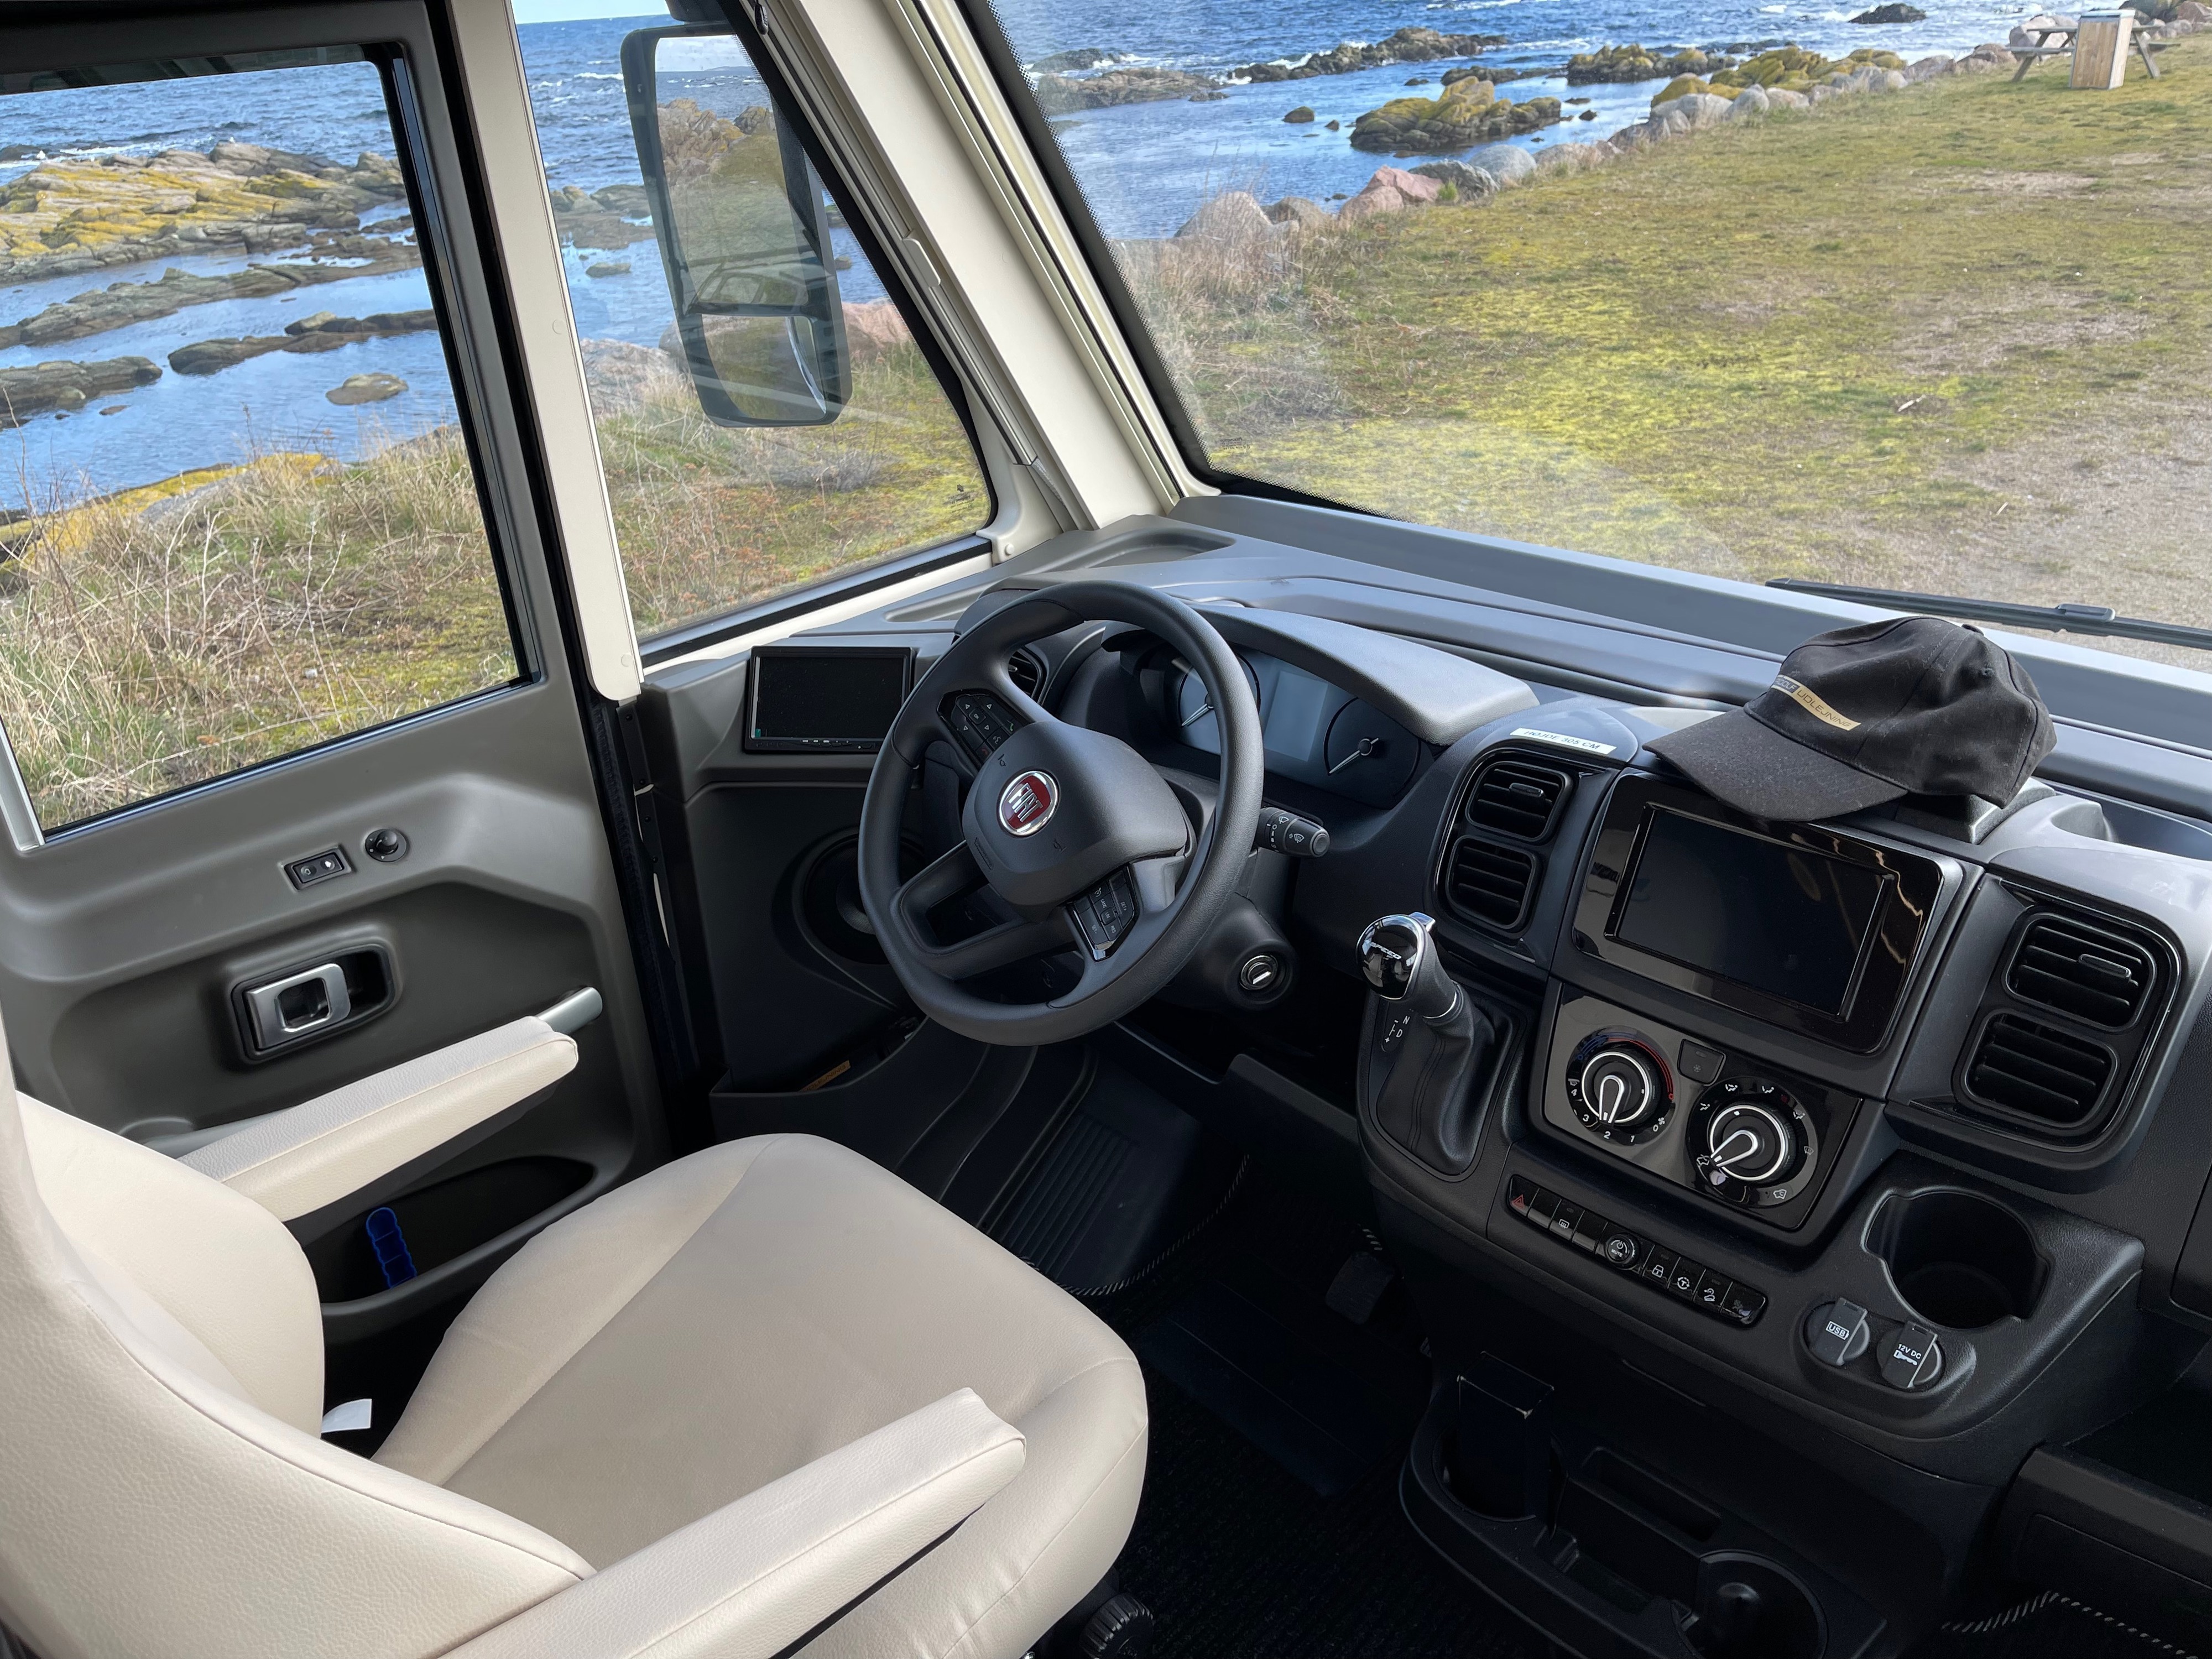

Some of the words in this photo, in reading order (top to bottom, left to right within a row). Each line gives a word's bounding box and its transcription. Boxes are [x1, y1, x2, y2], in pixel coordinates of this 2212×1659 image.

[1797, 689, 1852, 727] UDLEJNING
[1008, 782, 1044, 822] FIAT
[1403, 1015, 1410, 1025] N
[1396, 1029, 1403, 1037] D
[1604, 1131, 1611, 1139] 2
[1611, 1249, 1623, 1258] MUTE
[1828, 1323, 1846, 1338] USB
[1898, 1344, 1911, 1354] 12V
[1911, 1350, 1922, 1359] DC
